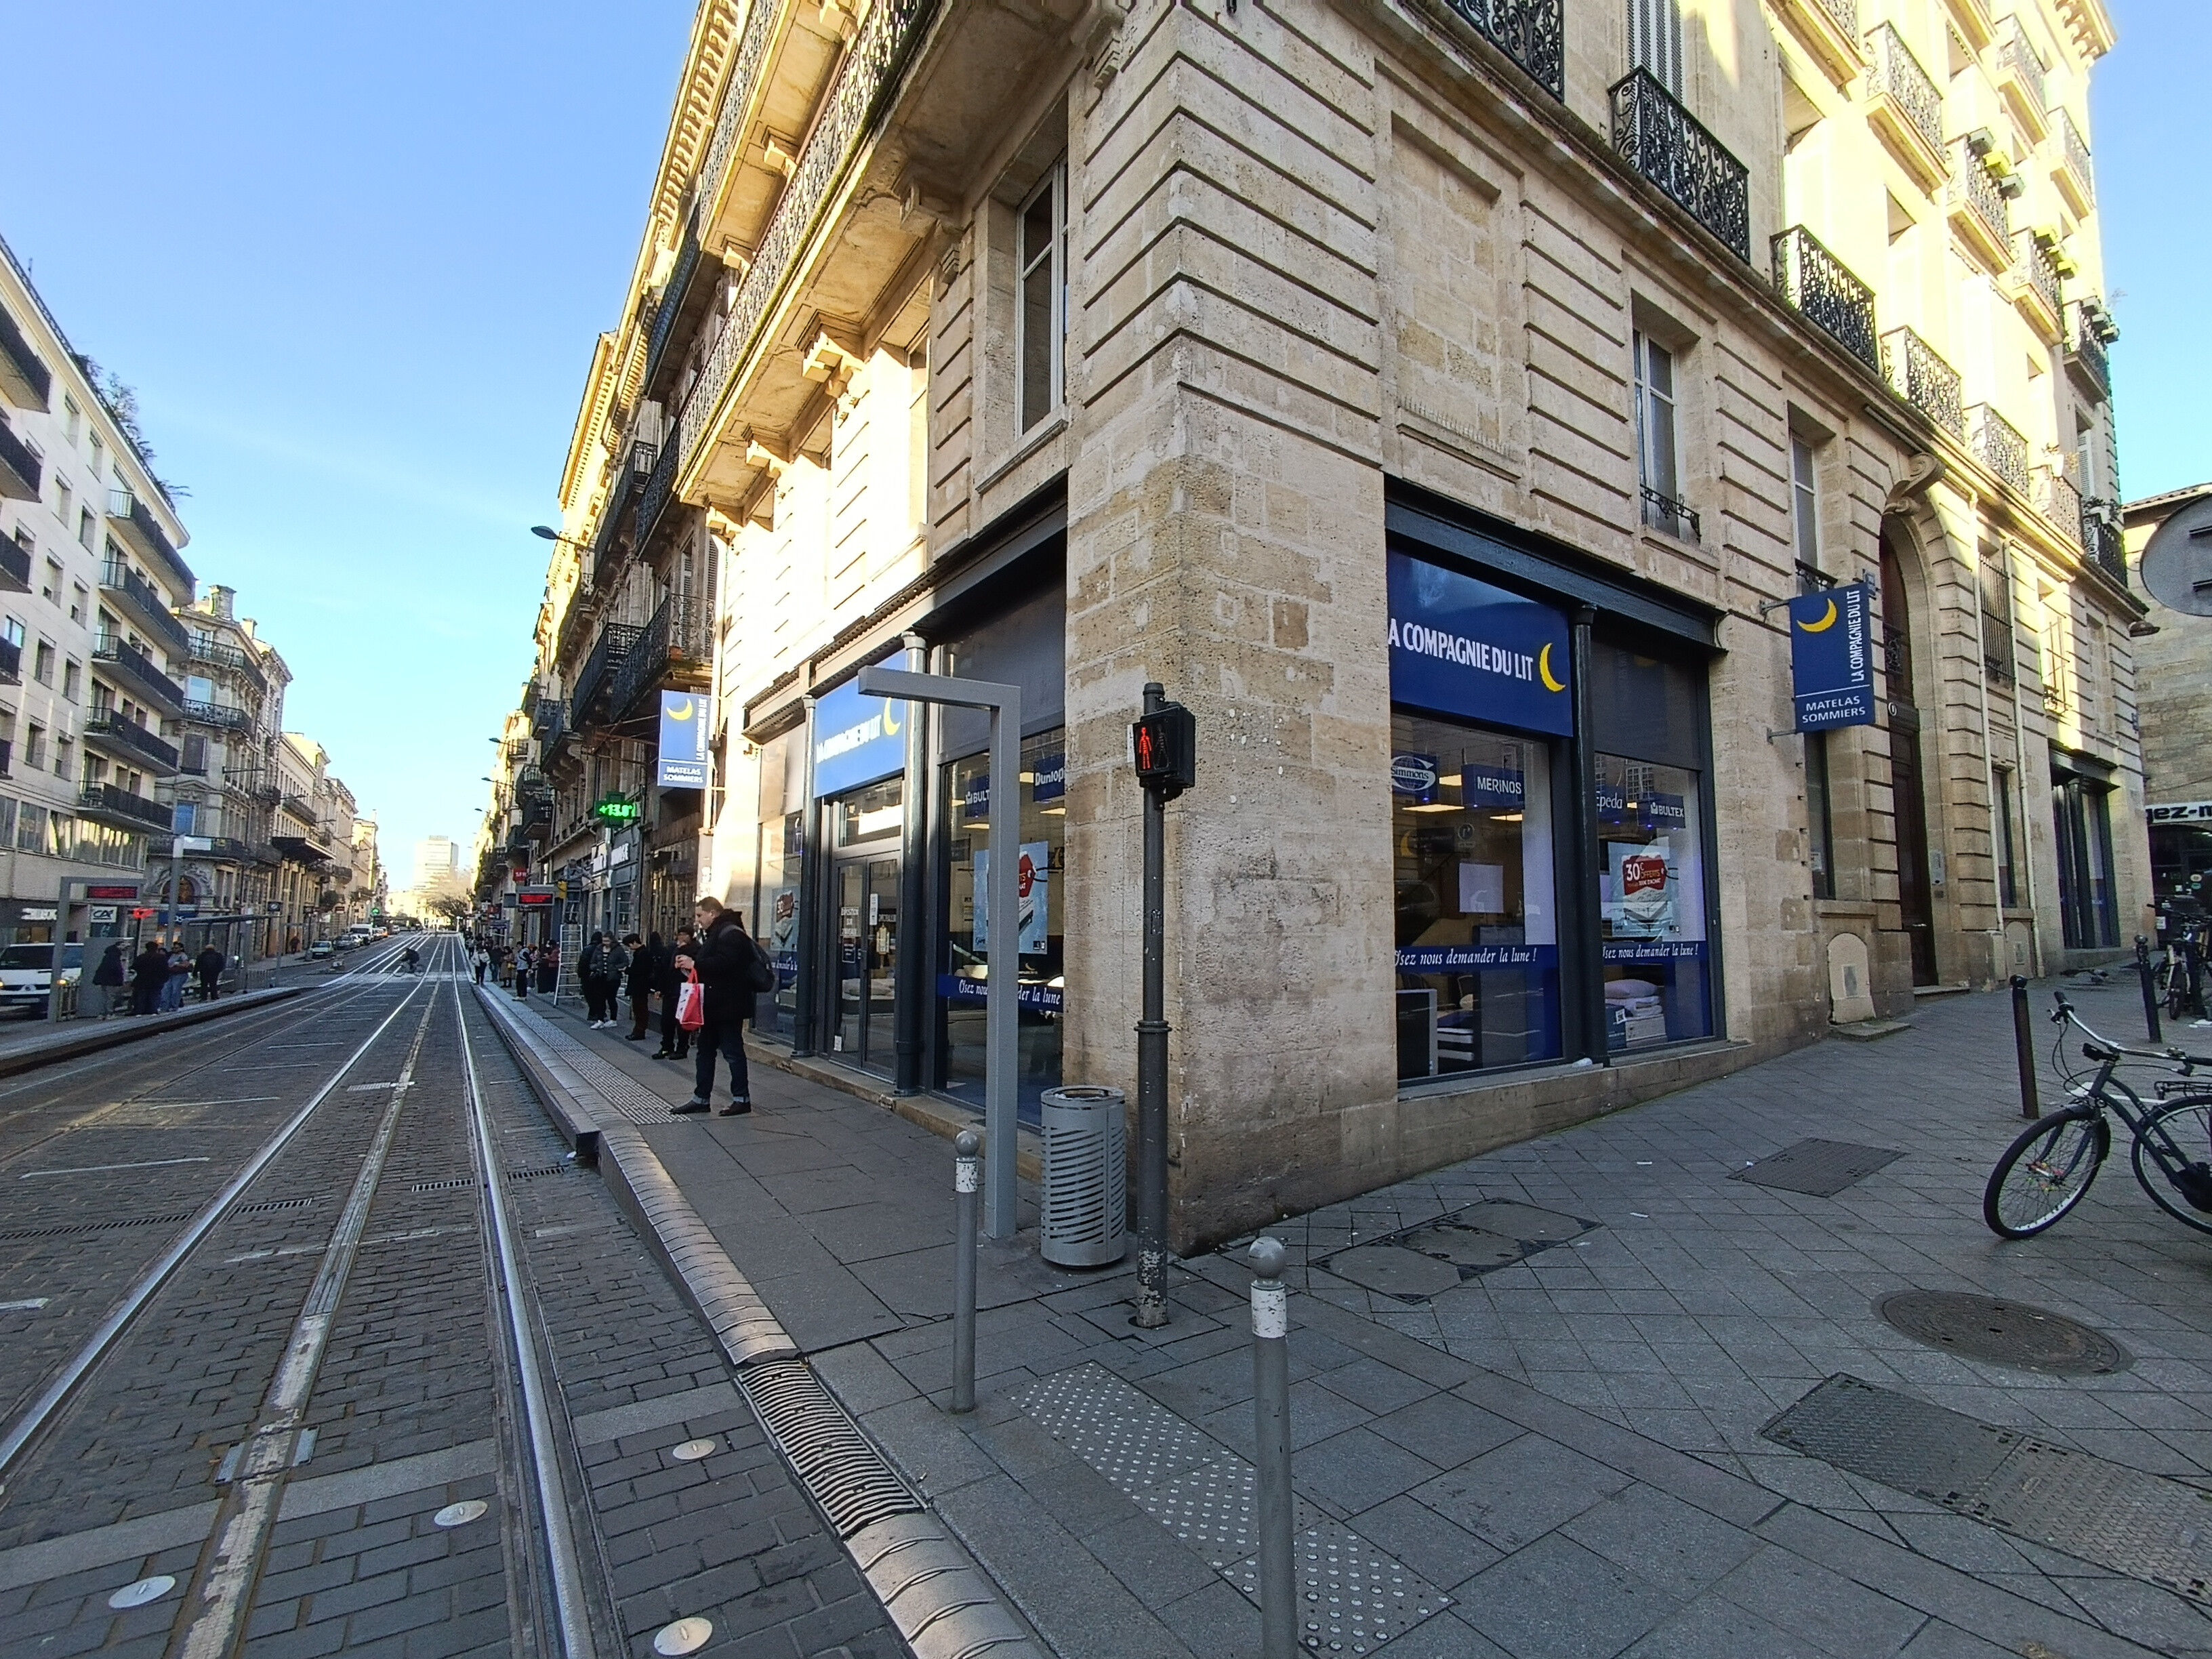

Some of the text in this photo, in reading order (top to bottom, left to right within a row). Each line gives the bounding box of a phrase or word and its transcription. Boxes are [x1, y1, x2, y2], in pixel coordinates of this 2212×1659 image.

[1847, 590, 1864, 682] LA COMPAGNIE DU LIT
[1403, 622, 1490, 671] COMPAGNIE
[1492, 647, 1512, 676] DU
[1515, 653, 1533, 681] LIT
[1805, 695, 1860, 712] MATELAS
[1802, 706, 1866, 723] SOMMIERS
[663, 774, 703, 783] SOMMIERS
[666, 766, 701, 775] MATELAS
[1035, 767, 1065, 786] Dunlop
[1391, 766, 1429, 779] Simmons
[1477, 777, 1521, 794] MERINOS
[1658, 805, 1684, 817] BULTEX
[1420, 954, 1442, 965] nous
[1446, 948, 1496, 964] demander
[1499, 947, 1508, 963] la
[1511, 947, 1530, 962] lune
[1618, 949, 1634, 958] nous
[1636, 945, 1669, 957] demander
[1672, 944, 1678, 956] la
[1680, 944, 1694, 956] lune
[958, 979, 974, 994] Osez
[1032, 986, 1040, 1002] la
[1043, 987, 1061, 1005] lune
